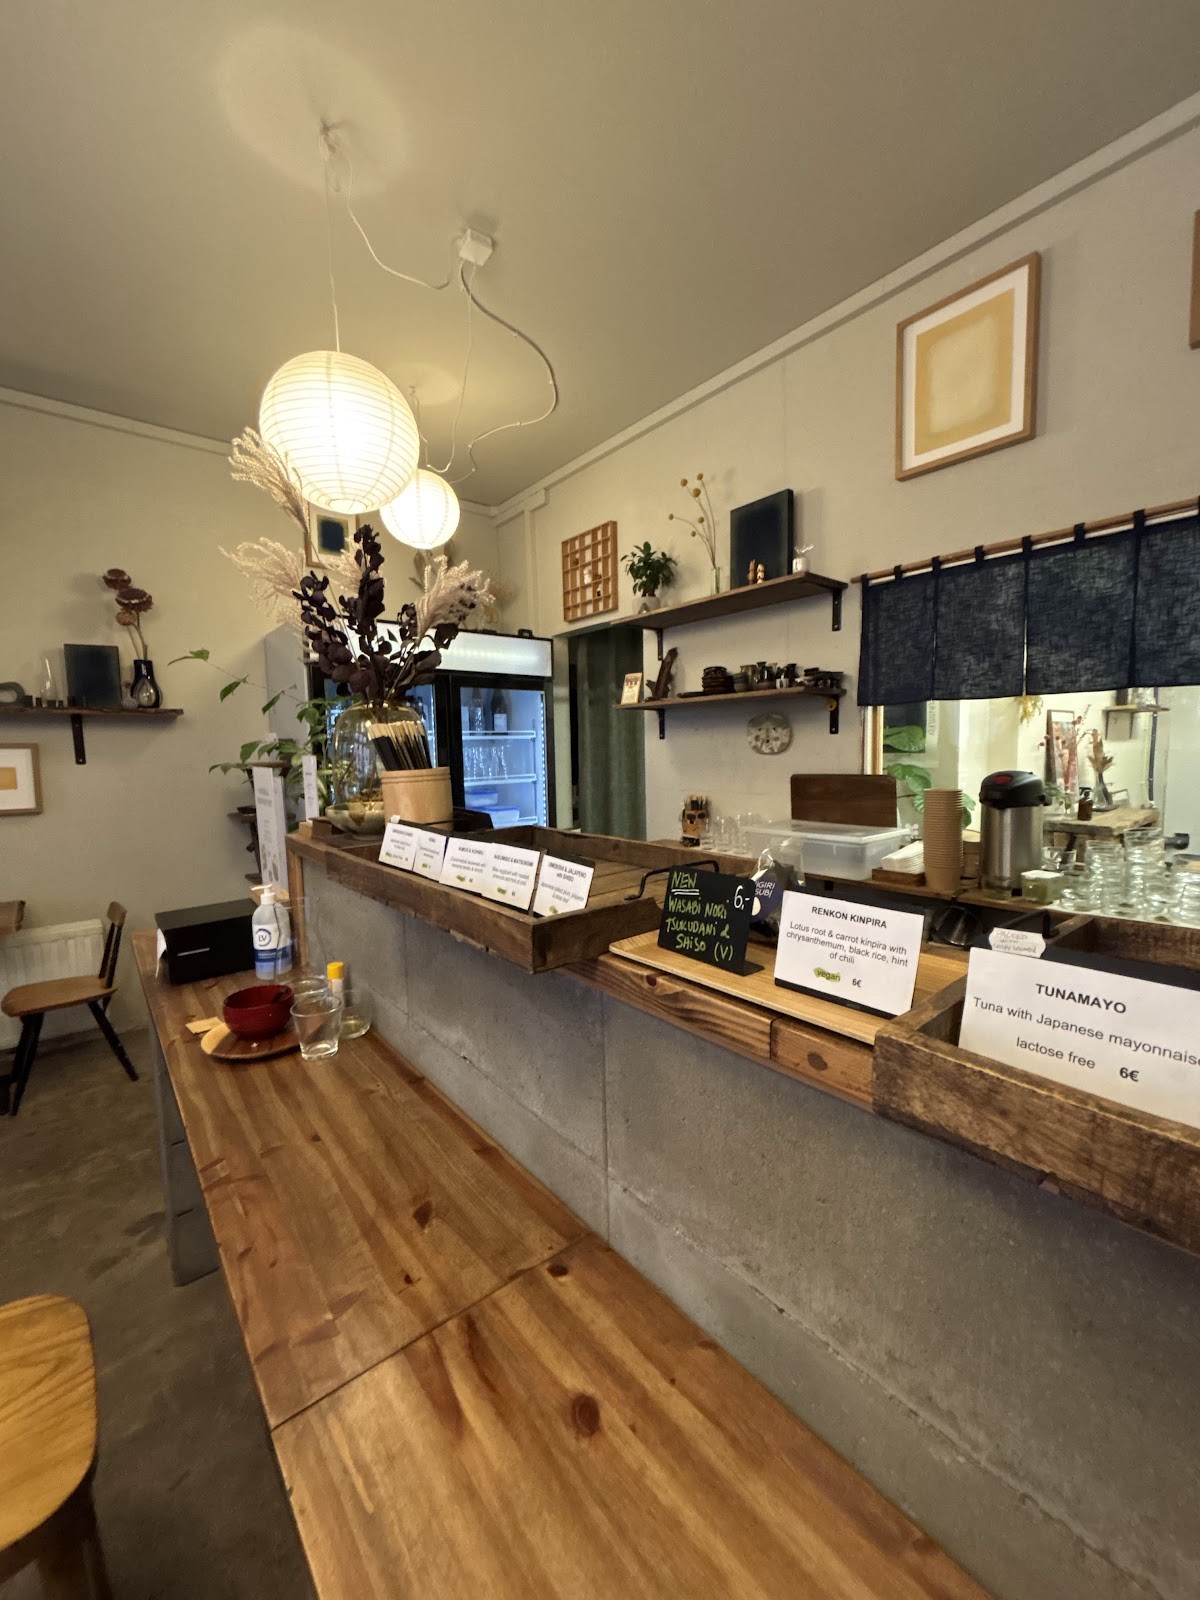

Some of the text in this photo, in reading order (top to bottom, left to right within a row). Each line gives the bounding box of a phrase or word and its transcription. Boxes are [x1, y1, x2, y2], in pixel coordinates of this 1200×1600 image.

[671, 871, 698, 889] NEW
[811, 906, 887, 929] RENKON KINPIRA
[258, 934, 267, 942] LV
[786, 931, 908, 968] chrysanthemum, black rice, hint
[790, 921, 907, 956] Lotus root & carrot kinpira with
[829, 951, 855, 965] of chili
[816, 968, 862, 989] vegan 6€
[1035, 983, 1127, 1015] TUNAMAYO
[973, 996, 1003, 1014] Tuna
[1007, 1006, 1033, 1022] with
[1036, 1013, 1104, 1041] Japanese
[1016, 1036, 1140, 1083] lactose free 6€
